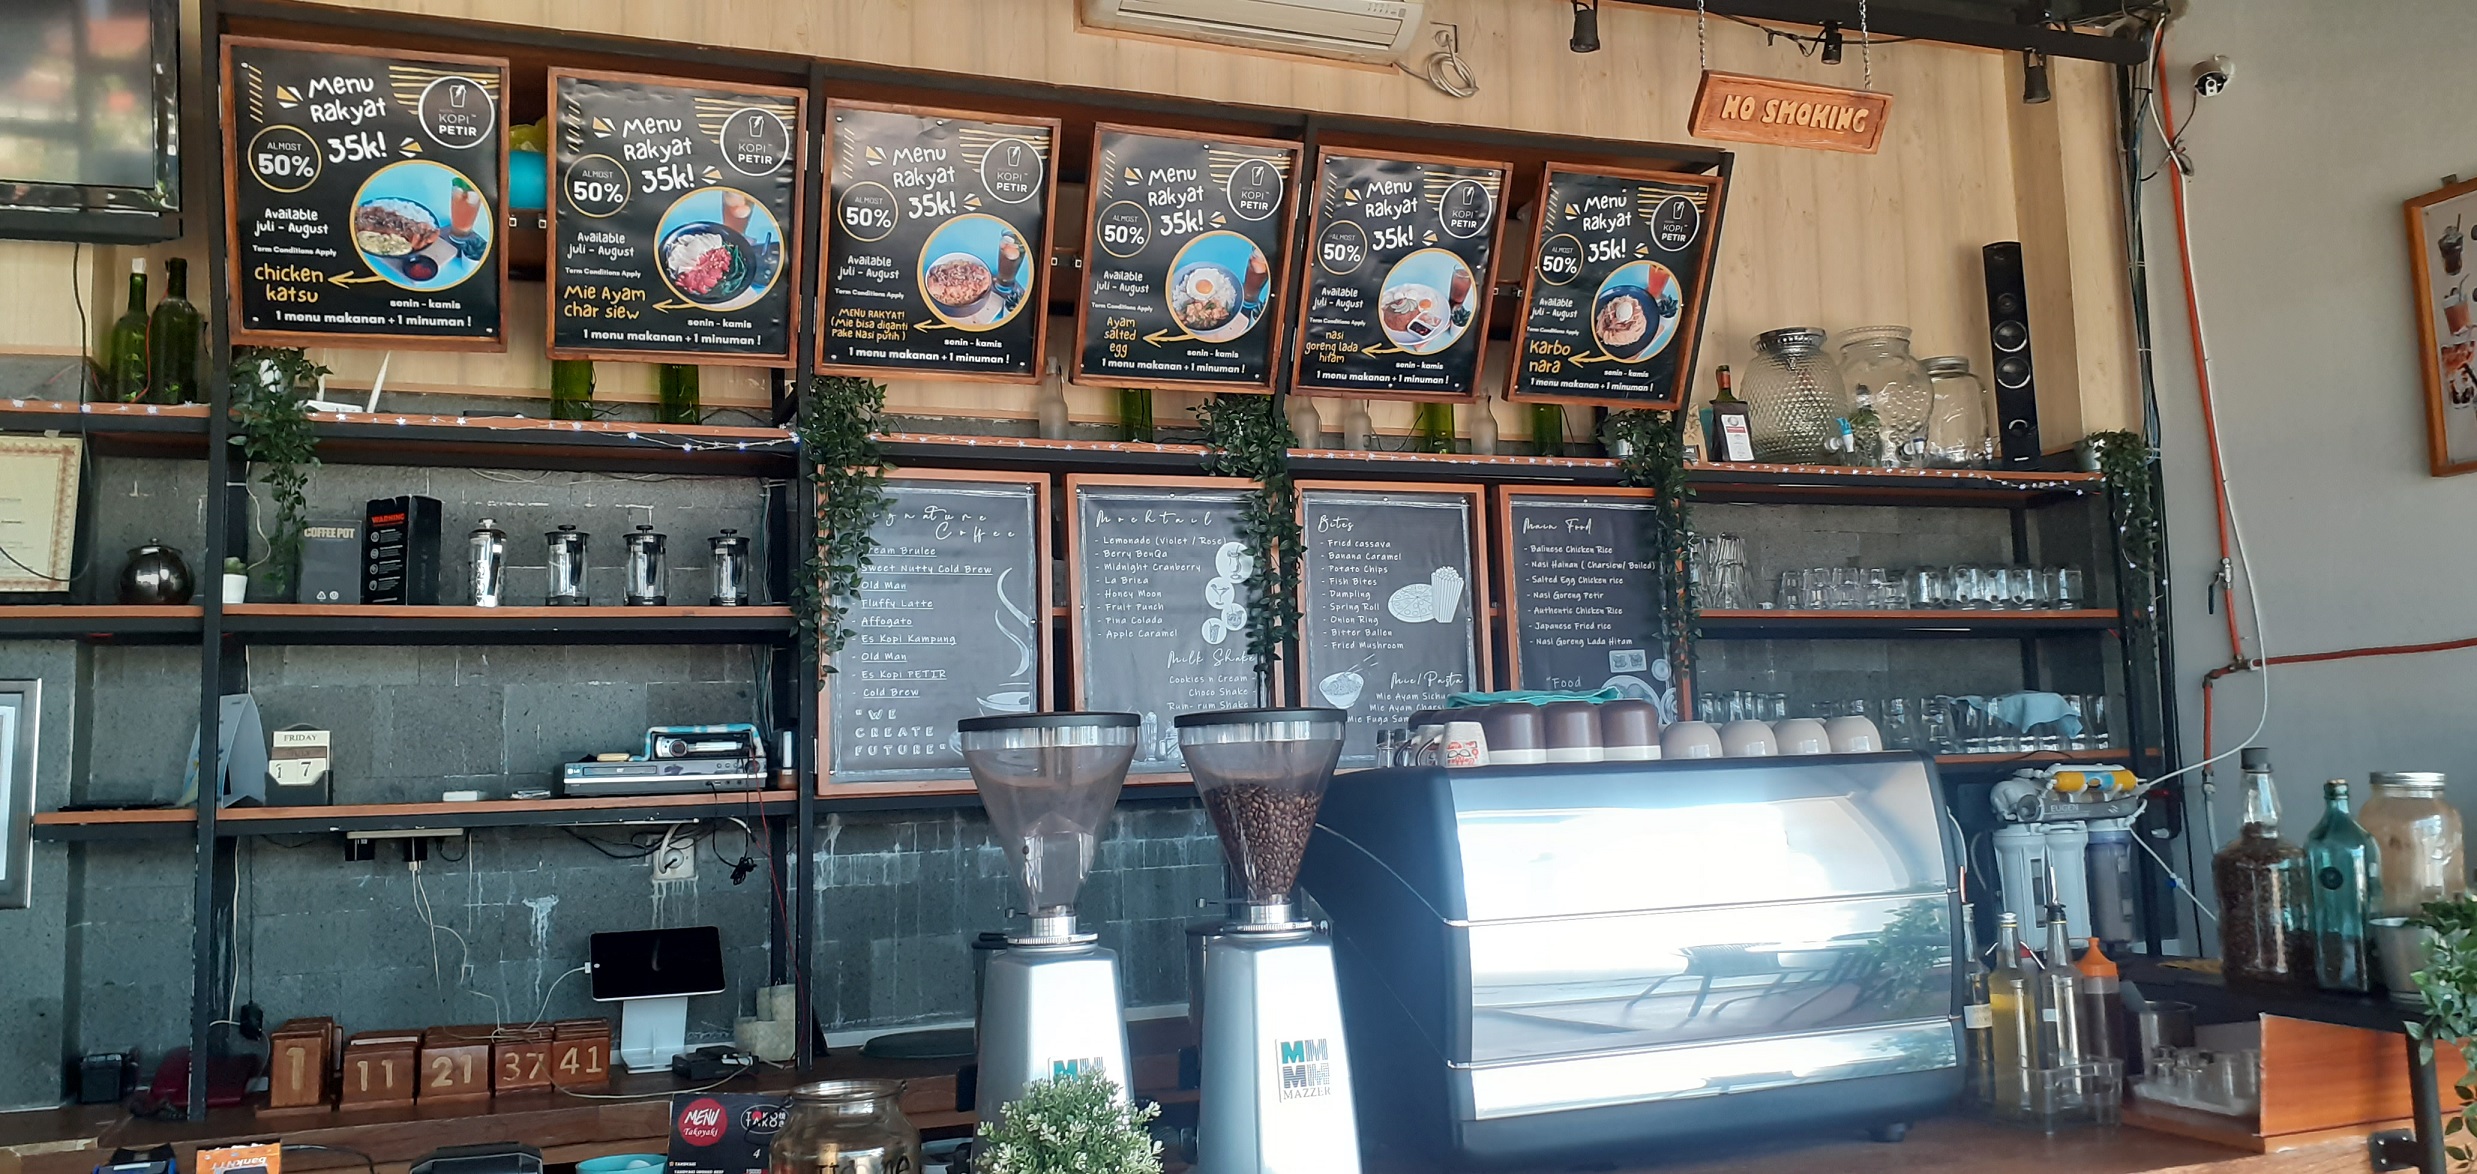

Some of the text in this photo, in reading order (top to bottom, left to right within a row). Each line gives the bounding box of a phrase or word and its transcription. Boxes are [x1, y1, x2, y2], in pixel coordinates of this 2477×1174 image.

[308, 75, 374, 98] Menu
[310, 98, 387, 125] Rakyat
[1721, 95, 1869, 132] NO SMOKING
[439, 113, 470, 124] KOPI
[438, 125, 477, 137] PETIR
[622, 117, 682, 138] Menu
[267, 142, 302, 151] ALMOST
[327, 131, 388, 163] 35k!
[623, 137, 692, 163] Rakyat
[738, 143, 766, 152] KOPI
[738, 154, 772, 164] PETIR
[893, 147, 946, 165] Menu
[258, 154, 314, 177] 50%
[582, 170, 613, 178] ALMOST
[642, 164, 695, 193] 35k!
[893, 165, 955, 190] Rakyat
[997, 172, 1022, 181] KOPI
[1148, 167, 1197, 186] Menu
[573, 182, 624, 203] 50%
[996, 182, 1027, 193] PETIR
[1366, 181, 1412, 198] Menu
[1148, 185, 1204, 210] Rakyat
[1241, 191, 1264, 200] KOPI
[908, 191, 957, 219] 35k!
[1240, 201, 1268, 211] PETIR
[1365, 197, 1418, 220] Rakyat
[1584, 194, 1627, 212] Menu
[265, 208, 318, 221] Available
[846, 207, 891, 228] 50%
[1453, 210, 1474, 218] KOPI
[1160, 209, 1204, 236] 35k!
[1451, 219, 1477, 229] PETIR
[1583, 213, 1632, 234] Rakyat
[1663, 224, 1683, 233] KOPI
[288, 223, 329, 239] August
[1104, 225, 1145, 245] 50%
[1372, 224, 1414, 251] 35k!
[1661, 233, 1686, 242] PETIR
[577, 232, 625, 244] Available
[598, 246, 634, 260] August
[1324, 243, 1361, 262] 50%
[1587, 238, 1626, 263] 35k!
[1543, 256, 1577, 274] 50%
[254, 263, 324, 283] chicken
[266, 283, 319, 303] katsu
[564, 285, 646, 303] Mie Ayam
[564, 302, 640, 320] char siew
[839, 308, 904, 320] MENU RAKYAT!
[831, 317, 908, 334] (Mie bisa diganti
[1107, 316, 1135, 329] Ayam
[832, 329, 853, 338] Pake
[855, 329, 875, 339] Nasi
[1104, 328, 1136, 341] salted
[1326, 330, 1344, 340] nasi
[1110, 344, 1128, 357] egg
[1305, 341, 1358, 355] goreng lada
[1319, 353, 1344, 364] hitam
[1529, 360, 1560, 373] nara
[372, 513, 405, 523] WARNING
[1318, 515, 1354, 533] Bites
[1523, 518, 1592, 534] Main Food
[304, 528, 355, 538] COFFEE POT
[1328, 539, 1390, 548] Fried cassava
[869, 547, 936, 555] ream Brulee
[1103, 550, 1131, 559] Berry
[861, 564, 992, 573] Sweet Nutty Cold Brew
[1104, 563, 1201, 573] Midnight Cranberry
[861, 581, 907, 589] Old Man
[1532, 576, 1557, 584] Salted
[1560, 576, 1575, 586] Egg
[1578, 576, 1606, 584] Chicken
[1105, 590, 1162, 599] Honey Moon
[1330, 590, 1371, 599] Dumpling
[1534, 591, 1551, 599] Nasi
[1553, 592, 1581, 601] Goreng
[861, 599, 933, 608] Fluffy Latte
[1330, 603, 1379, 612] Spring Roll
[861, 617, 912, 626] Affogato
[1535, 622, 1572, 631] Japanese
[862, 635, 956, 645] Es Kopi Kampung
[1106, 630, 1133, 638] Apple
[862, 670, 946, 679] Es Kopi PETIR
[1189, 688, 1215, 696] Choco
[855, 726, 934, 738] CREATE
[301, 762, 311, 776] 7
[559, 1045, 602, 1074] 41
[286, 1048, 306, 1090] 1
[431, 1056, 472, 1088] 21
[503, 1053, 544, 1081] 37
[357, 1060, 393, 1091] 11
[1283, 1087, 1331, 1099] MAZZER
[684, 1108, 720, 1126] MENU
[683, 1127, 718, 1137] Takoyaki
